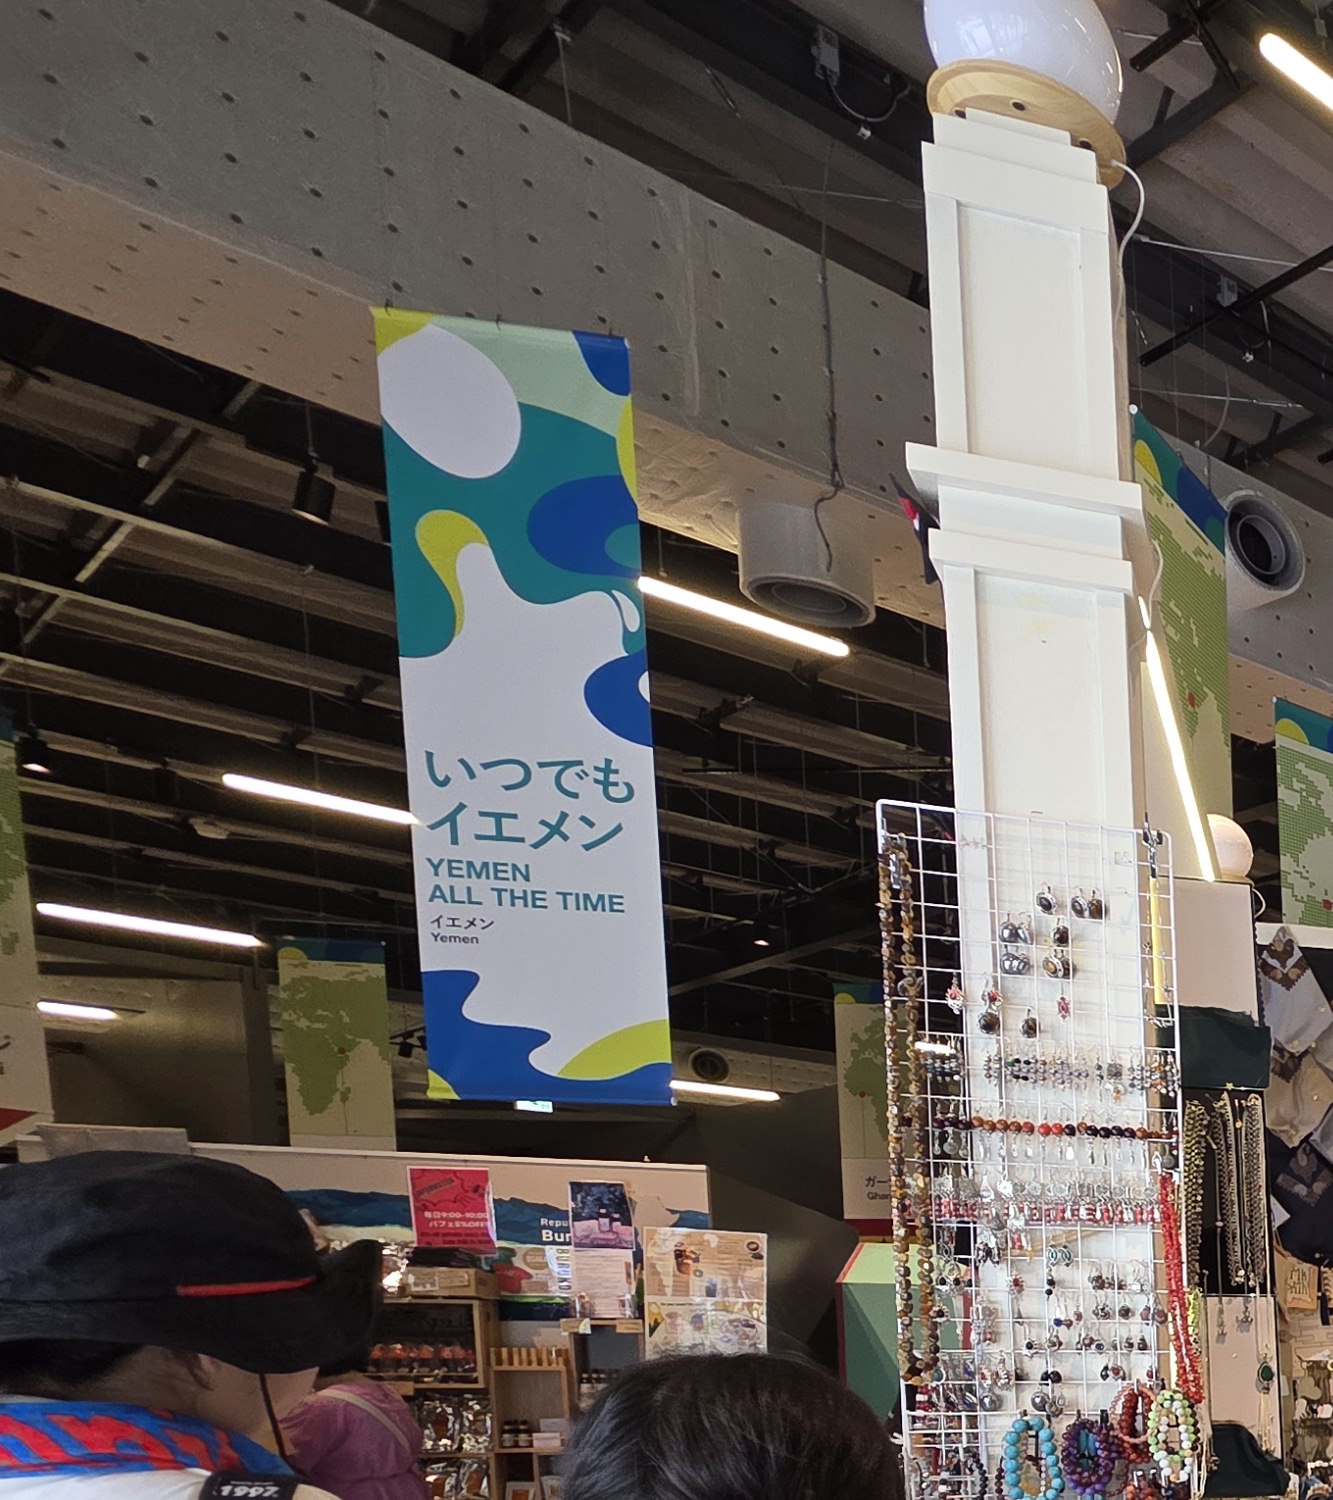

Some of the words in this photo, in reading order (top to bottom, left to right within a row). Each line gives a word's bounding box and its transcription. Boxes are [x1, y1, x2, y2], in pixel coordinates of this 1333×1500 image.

[424, 749, 635, 803] いつでも
[426, 801, 624, 852] イエメン
[425, 857, 531, 883] YEMEN
[428, 883, 484, 906] ALL
[490, 887, 549, 910] THE
[555, 891, 626, 914] TIME
[430, 914, 495, 931] イエメン
[430, 931, 480, 945] Yemen
[864, 1176, 891, 1188] ガー
